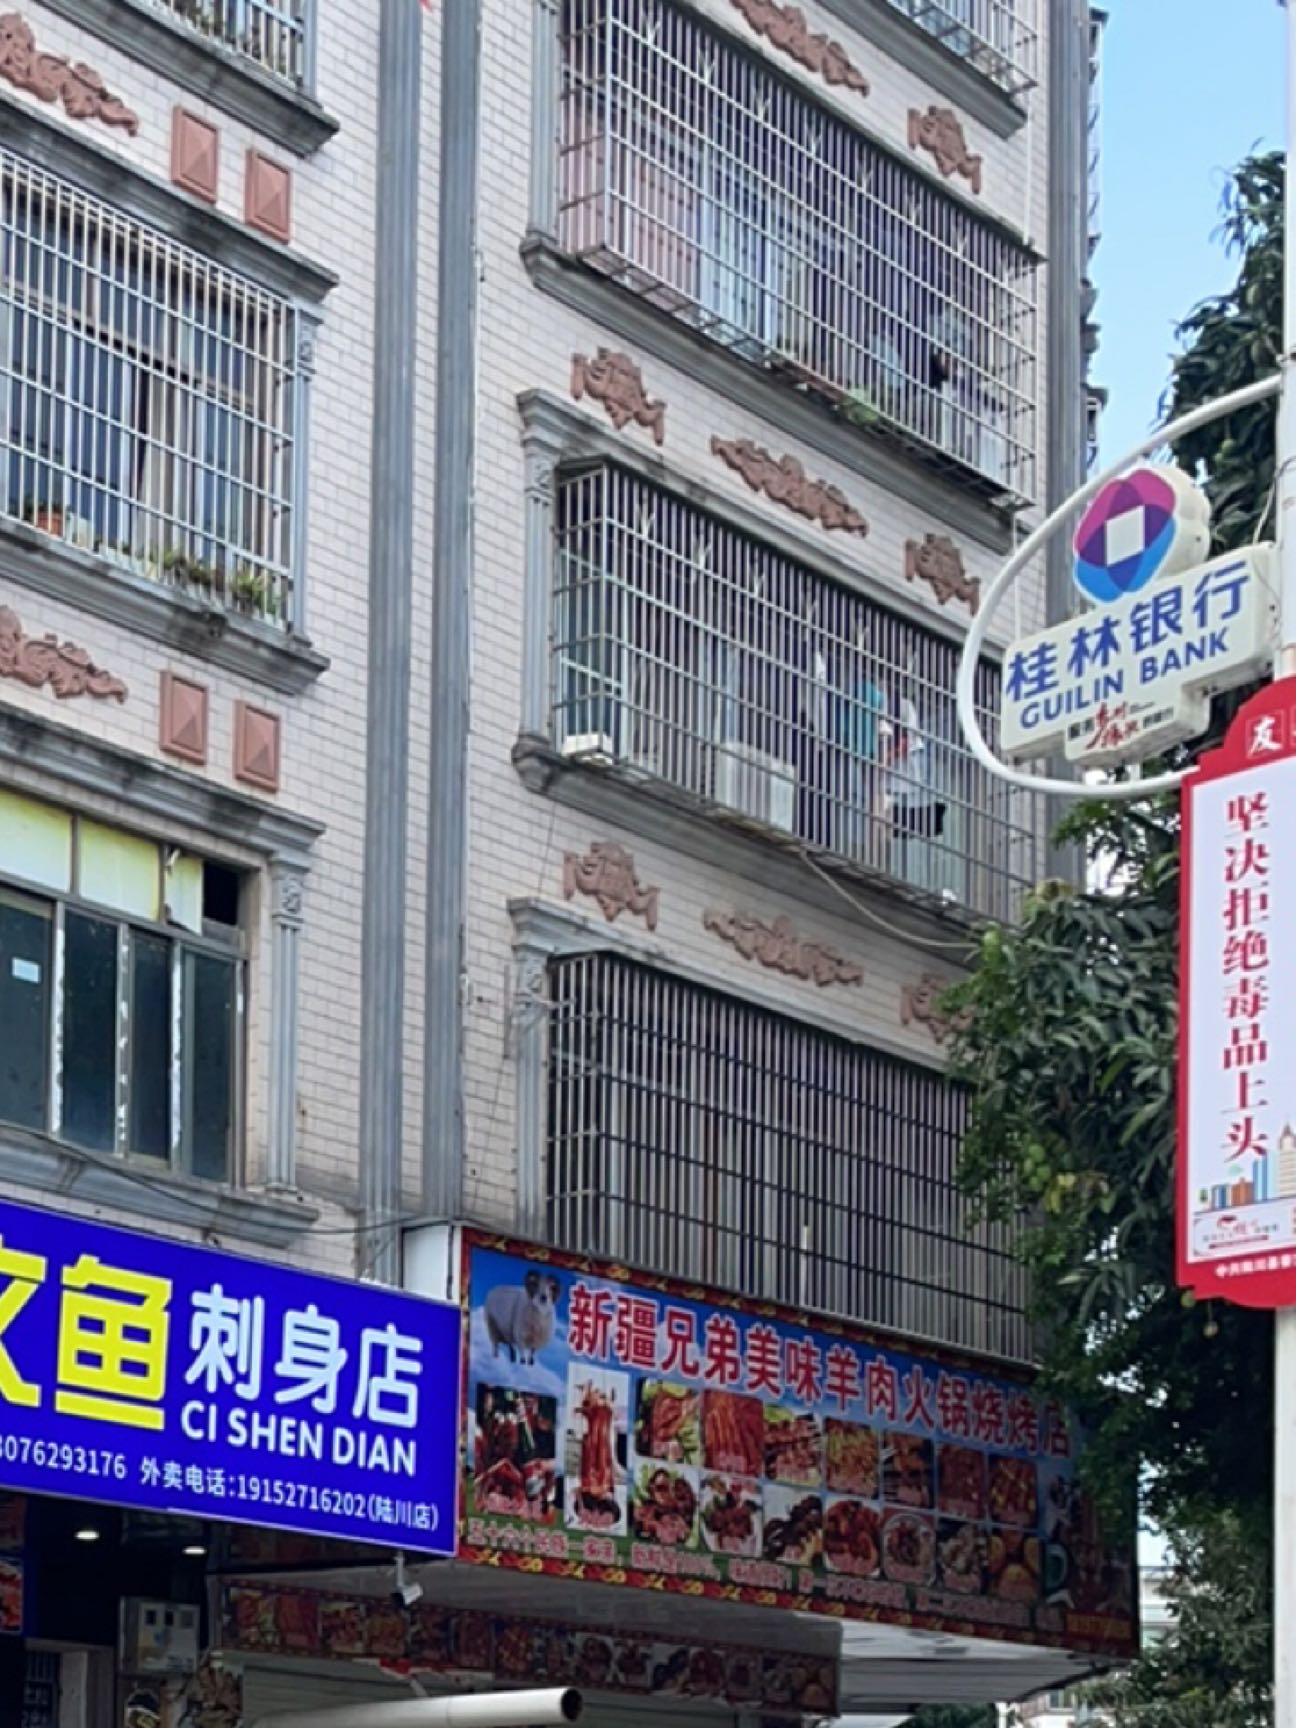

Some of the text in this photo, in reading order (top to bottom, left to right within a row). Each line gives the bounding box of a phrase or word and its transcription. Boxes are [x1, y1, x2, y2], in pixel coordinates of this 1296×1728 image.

[1006, 560, 1251, 702] 桂林银行
[1020, 669, 1125, 730] GUILIN
[1139, 626, 1232, 685] BANK
[1221, 791, 1270, 1164] 坚决拒绝毒品上头
[185, 1283, 423, 1429] 刺身店
[568, 1281, 1073, 1459] 新疆兄弟美味羊肉火锅烧烤店
[181, 1400, 417, 1478] CI SHEN DIAN
